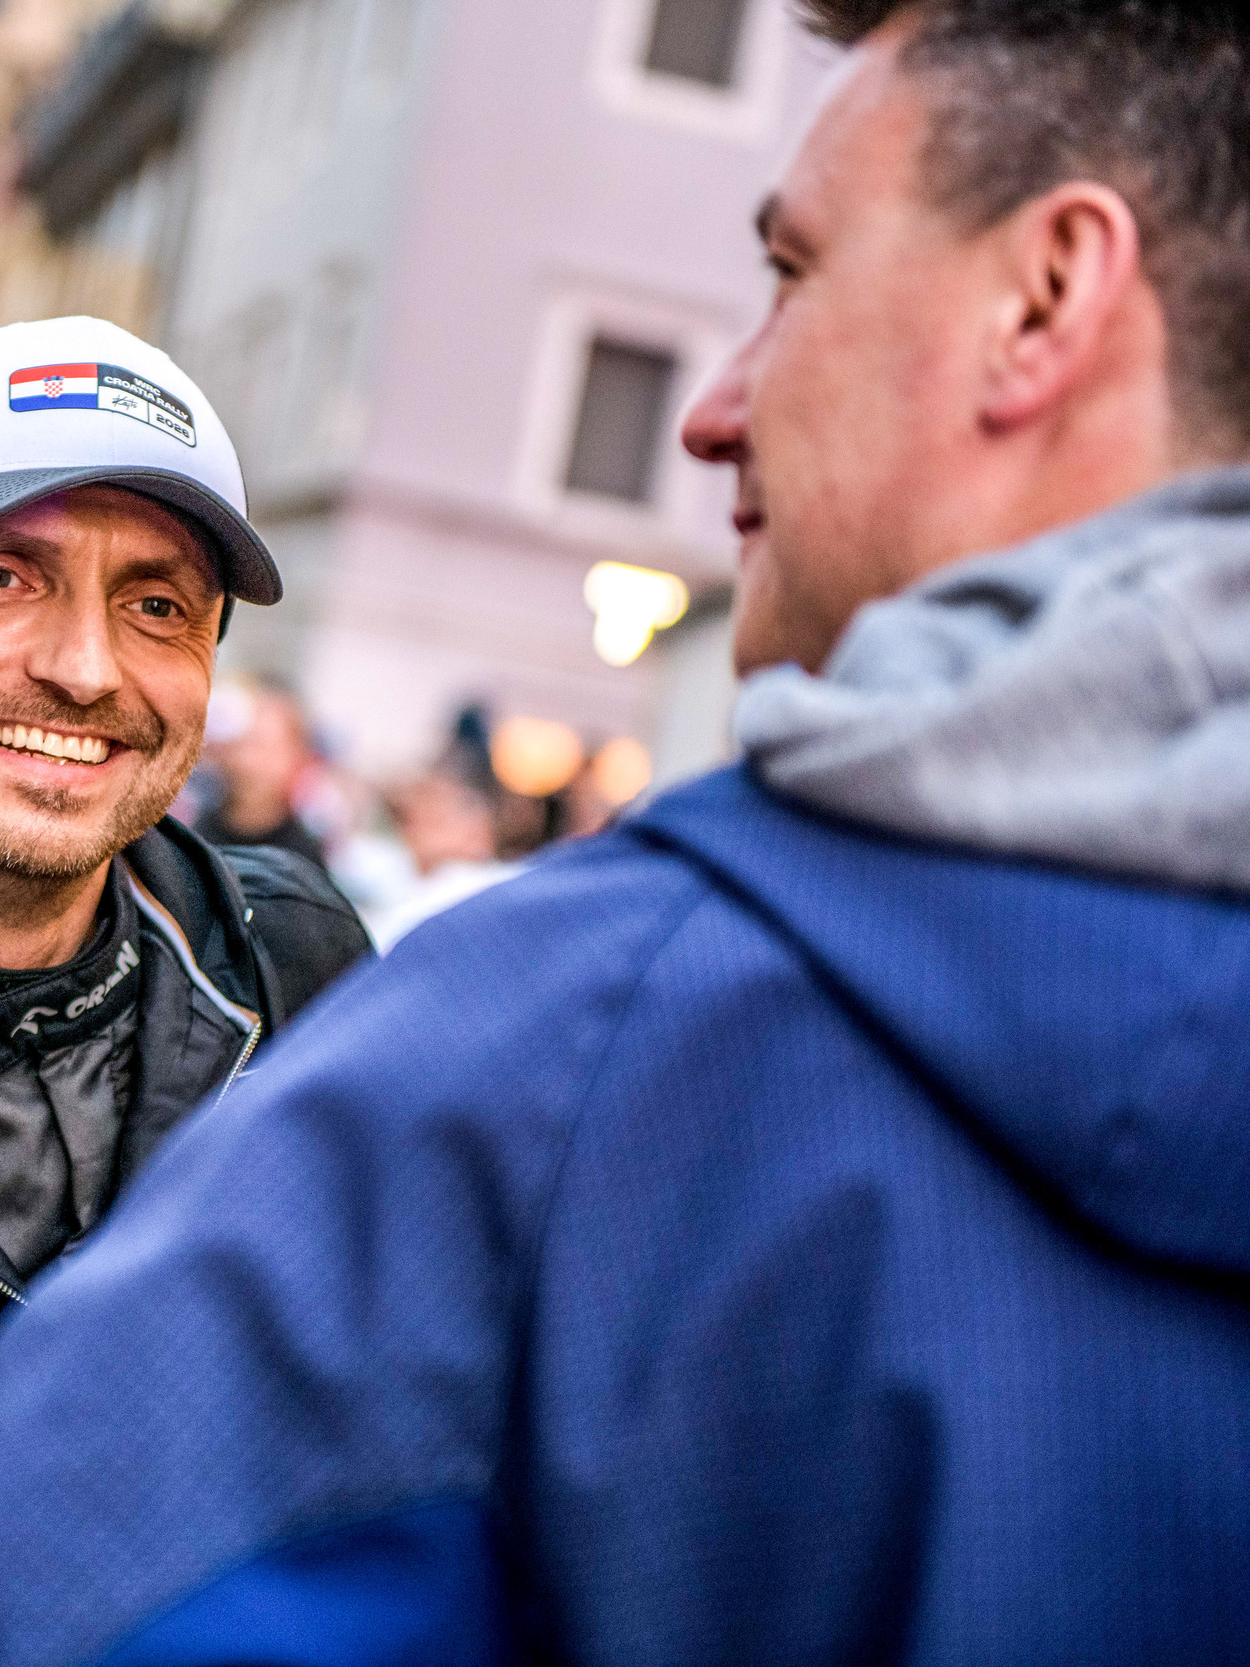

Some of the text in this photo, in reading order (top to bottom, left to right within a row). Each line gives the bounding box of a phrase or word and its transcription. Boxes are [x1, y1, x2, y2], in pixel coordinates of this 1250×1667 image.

[104, 376, 188, 420] CROATIA RALLY
[134, 378, 161, 395] WRC
[157, 414, 189, 438] 2026
